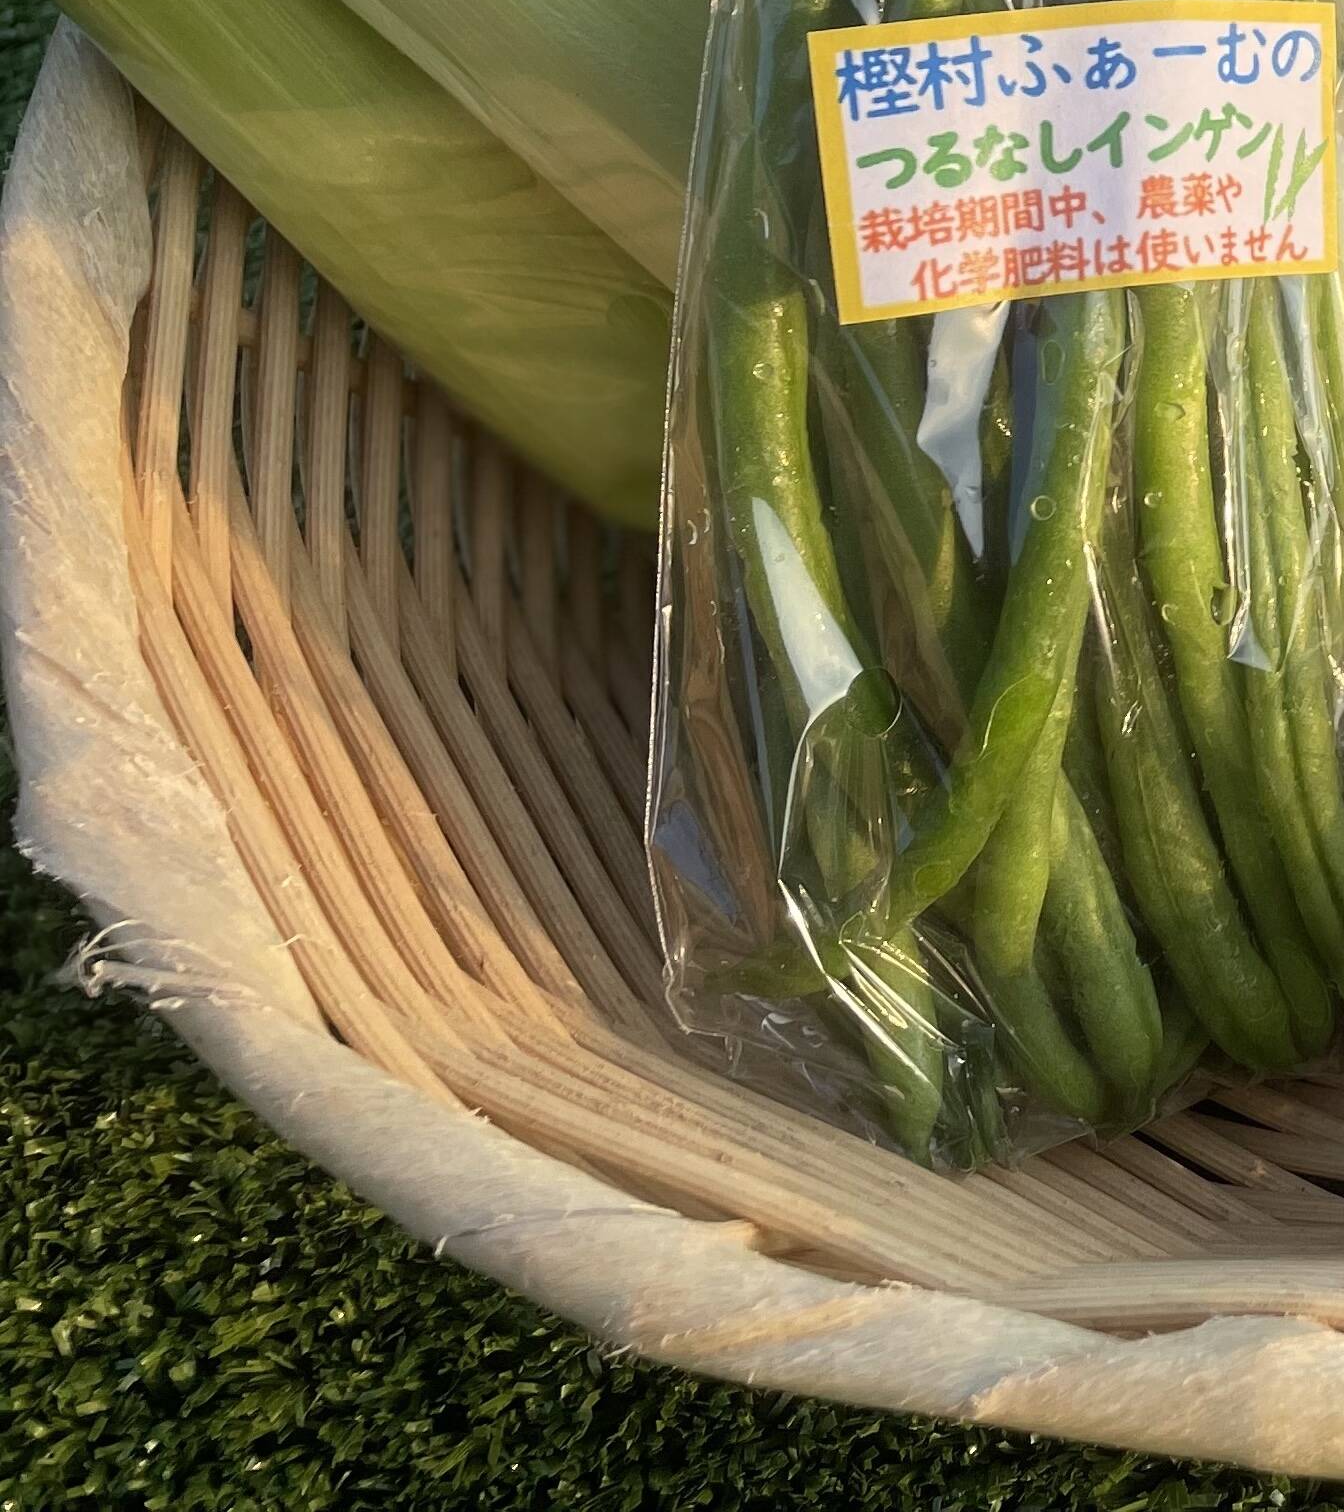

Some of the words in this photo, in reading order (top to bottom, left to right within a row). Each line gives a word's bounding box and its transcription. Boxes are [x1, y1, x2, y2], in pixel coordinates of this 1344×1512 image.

[835, 22, 1322, 122] 樫村ふぁーむの
[856, 102, 1272, 189] つるなしインゲン
[911, 225, 1308, 302] 化学肥料は使いません
